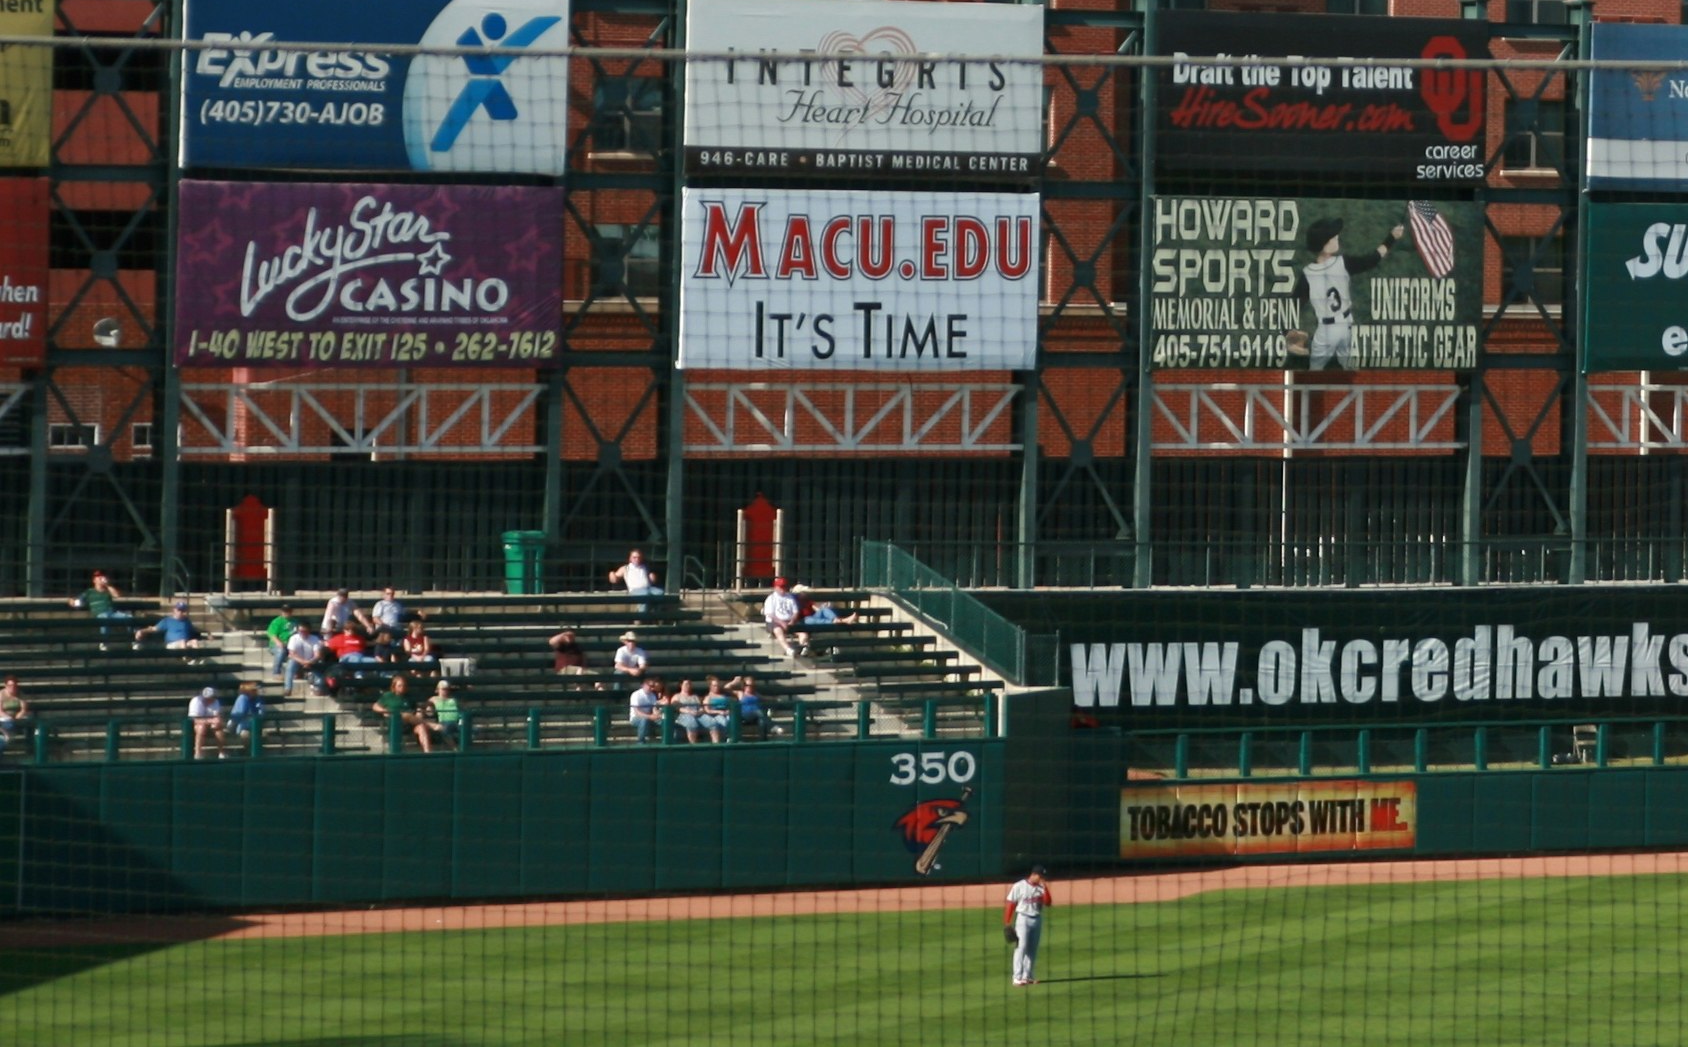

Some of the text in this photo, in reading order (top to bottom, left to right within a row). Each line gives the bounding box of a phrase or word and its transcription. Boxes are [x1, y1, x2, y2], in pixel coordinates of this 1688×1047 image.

[234, 77, 386, 91] EMPLOYMENT PROFESSIONALS
[726, 46, 1007, 91] INTEGRIS
[1173, 52, 1413, 95] Draft the Top Talent
[200, 98, 385, 126] (405)730-AJOB
[776, 88, 1005, 136] Heart Hospital
[1170, 85, 1416, 131] HireSooner.com
[699, 150, 1029, 172] 946-CARE BAPTIST MEDICAL CENTER
[1416, 161, 1484, 179] services
[1425, 144, 1478, 159] career
[343, 195, 449, 260] Star
[693, 200, 1032, 287] MACU.EDU
[1155, 199, 1300, 246] HOWARD
[240, 207, 350, 322] Lucky
[1152, 249, 1296, 298] SPORTS
[0, 276, 38, 302] hen
[340, 277, 509, 312] CASINO
[1326, 286, 1341, 312] 3
[1370, 277, 1456, 320] UNIFORMS
[755, 301, 968, 360] IT'S TIME
[1153, 297, 1300, 330] MEMORIAL & PENN
[245, 330, 303, 360] WEST
[309, 331, 336, 361] TO
[340, 332, 387, 360] EXIT
[391, 332, 428, 360] 125
[451, 330, 556, 361] 262-7612
[1153, 334, 1287, 368] 405-751-9119
[1348, 324, 1477, 368] ATHLETIC GEAR
[889, 750, 976, 786] 350
[1128, 803, 1228, 841] TOBACCO
[1232, 801, 1305, 837] STOPS
[1309, 798, 1365, 833] WITH
